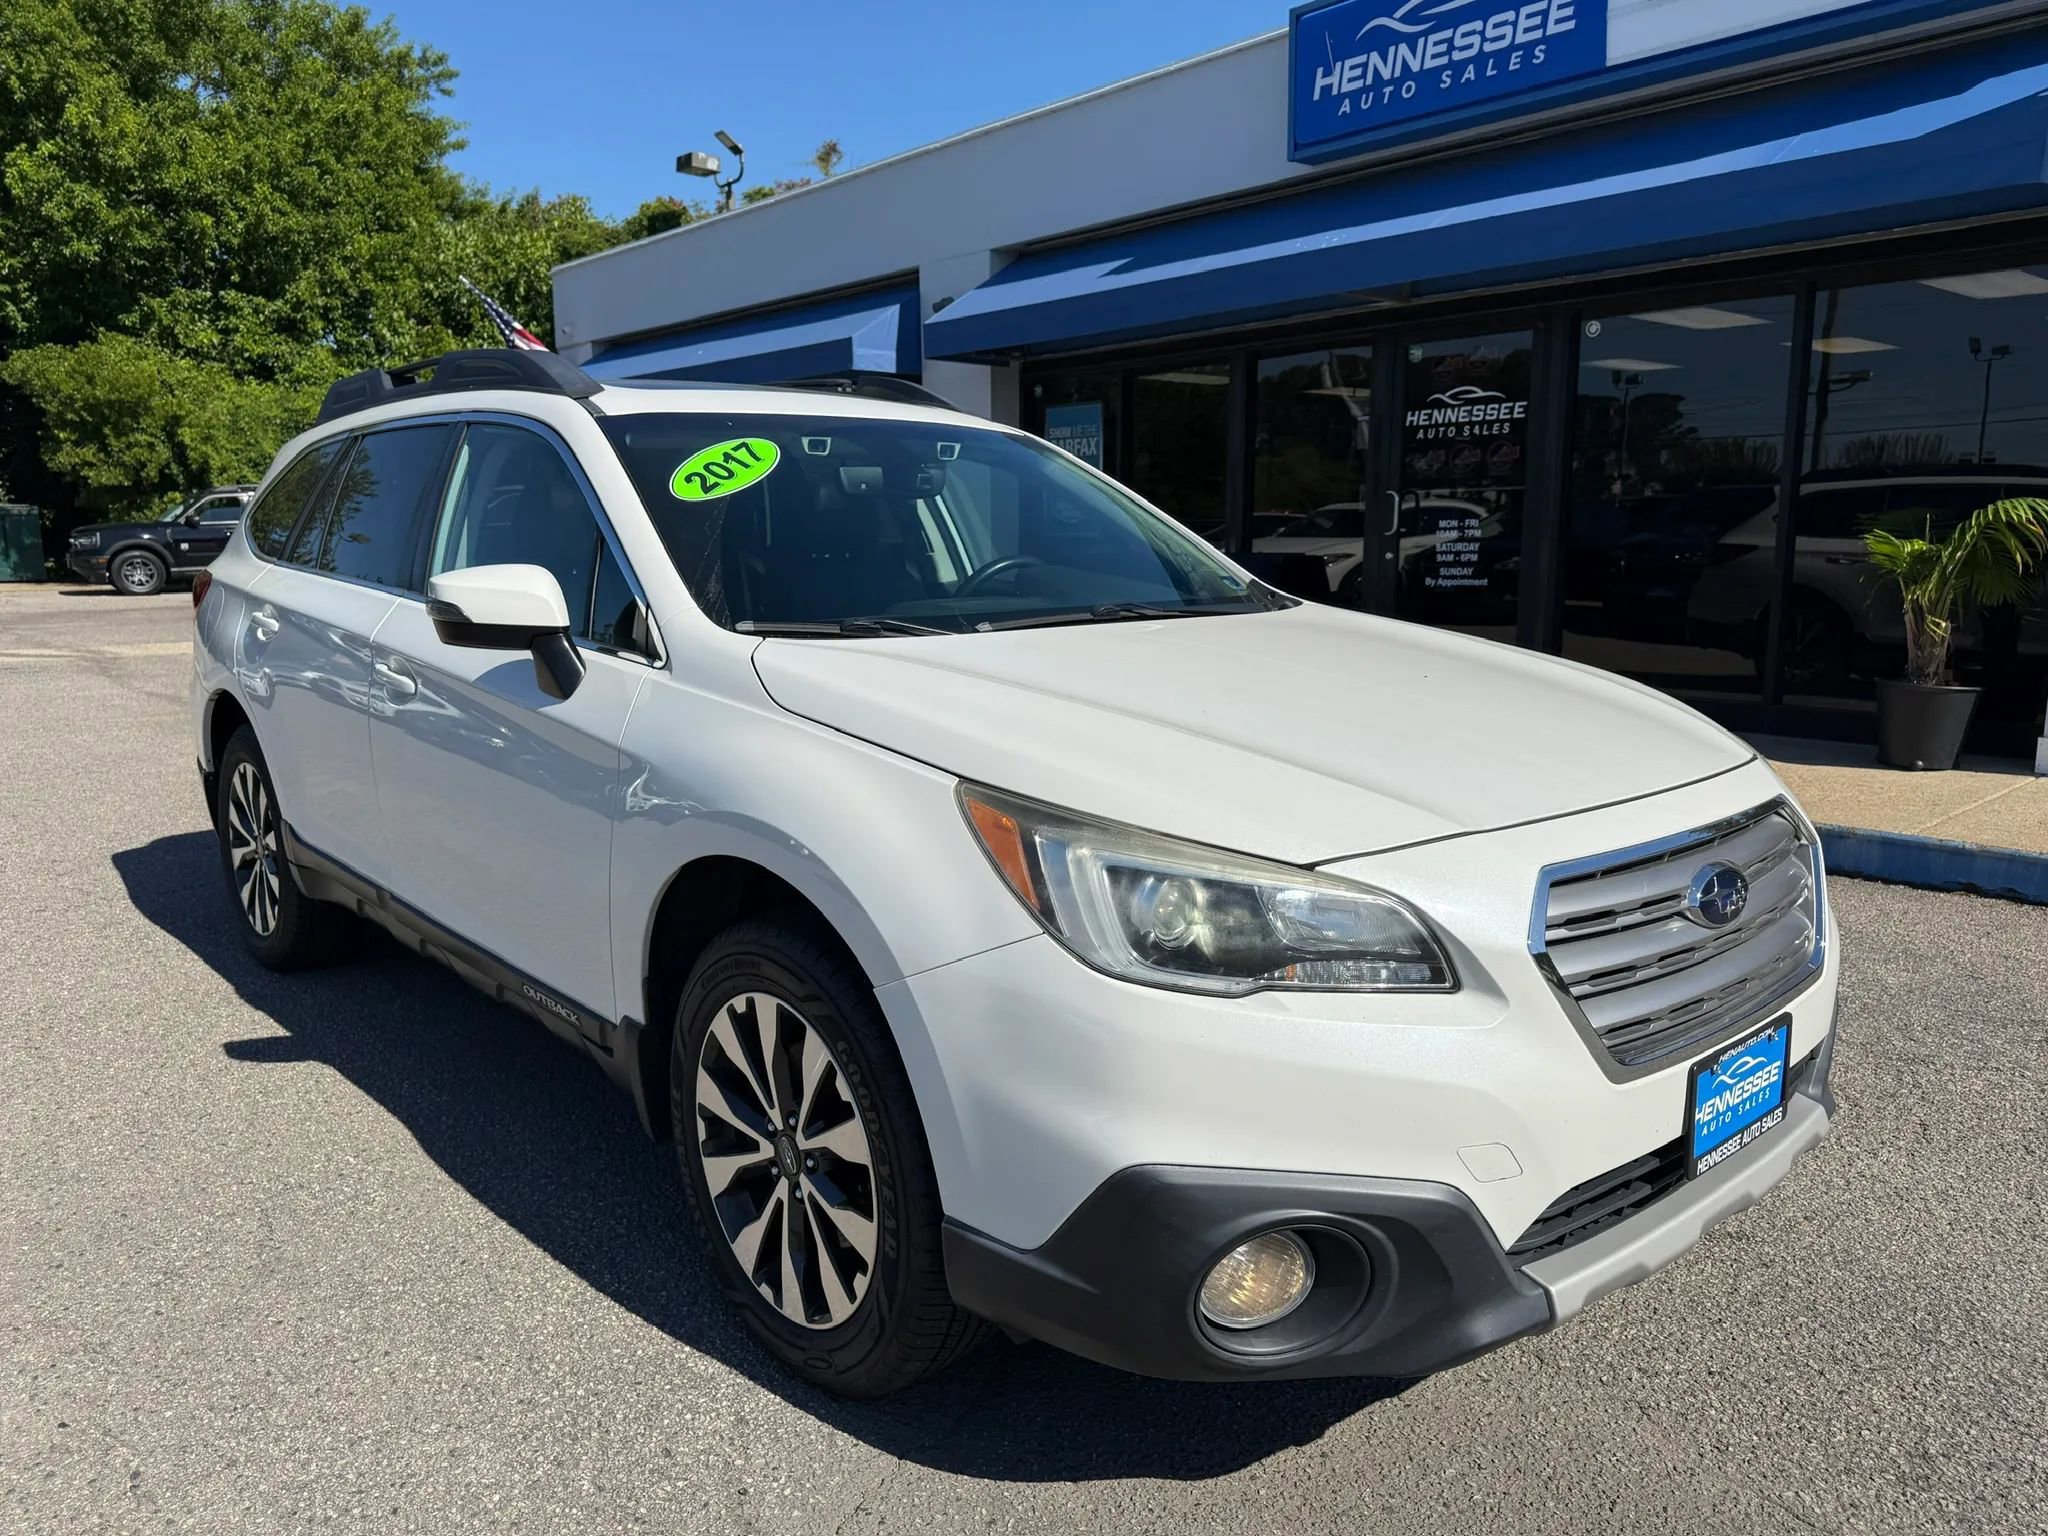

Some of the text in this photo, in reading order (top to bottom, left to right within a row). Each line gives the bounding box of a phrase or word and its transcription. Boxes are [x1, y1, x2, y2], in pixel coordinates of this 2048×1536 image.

[1312, 0, 1577, 101] HENNESSEE
[1338, 45, 1548, 116] AUTO SALES
[1405, 401, 1529, 427] HENNESSEE
[1048, 426, 1072, 438] SHOW
[1416, 422, 1511, 440] AUTO SALES
[683, 441, 764, 495] 2017
[1436, 529, 1459, 538] 10AM
[1463, 529, 1482, 538] 7PM
[1438, 519, 1459, 528] MON
[1464, 519, 1480, 528] FRI
[1435, 542, 1480, 552] SATURDAY
[1436, 553, 1454, 562] 9AM
[1460, 553, 1479, 562] 6PM
[1425, 577, 1488, 588] By Appointment
[1439, 567, 1474, 576] SUNDAY
[523, 984, 581, 1026] OUTBACK
[1718, 1026, 1775, 1064] HENAUTO.COM
[1694, 1060, 1782, 1125] HENNESSEE
[1701, 1087, 1770, 1137] AUTO SALES
[1696, 1107, 1783, 1176] HENNESSEE AUTO SALES
